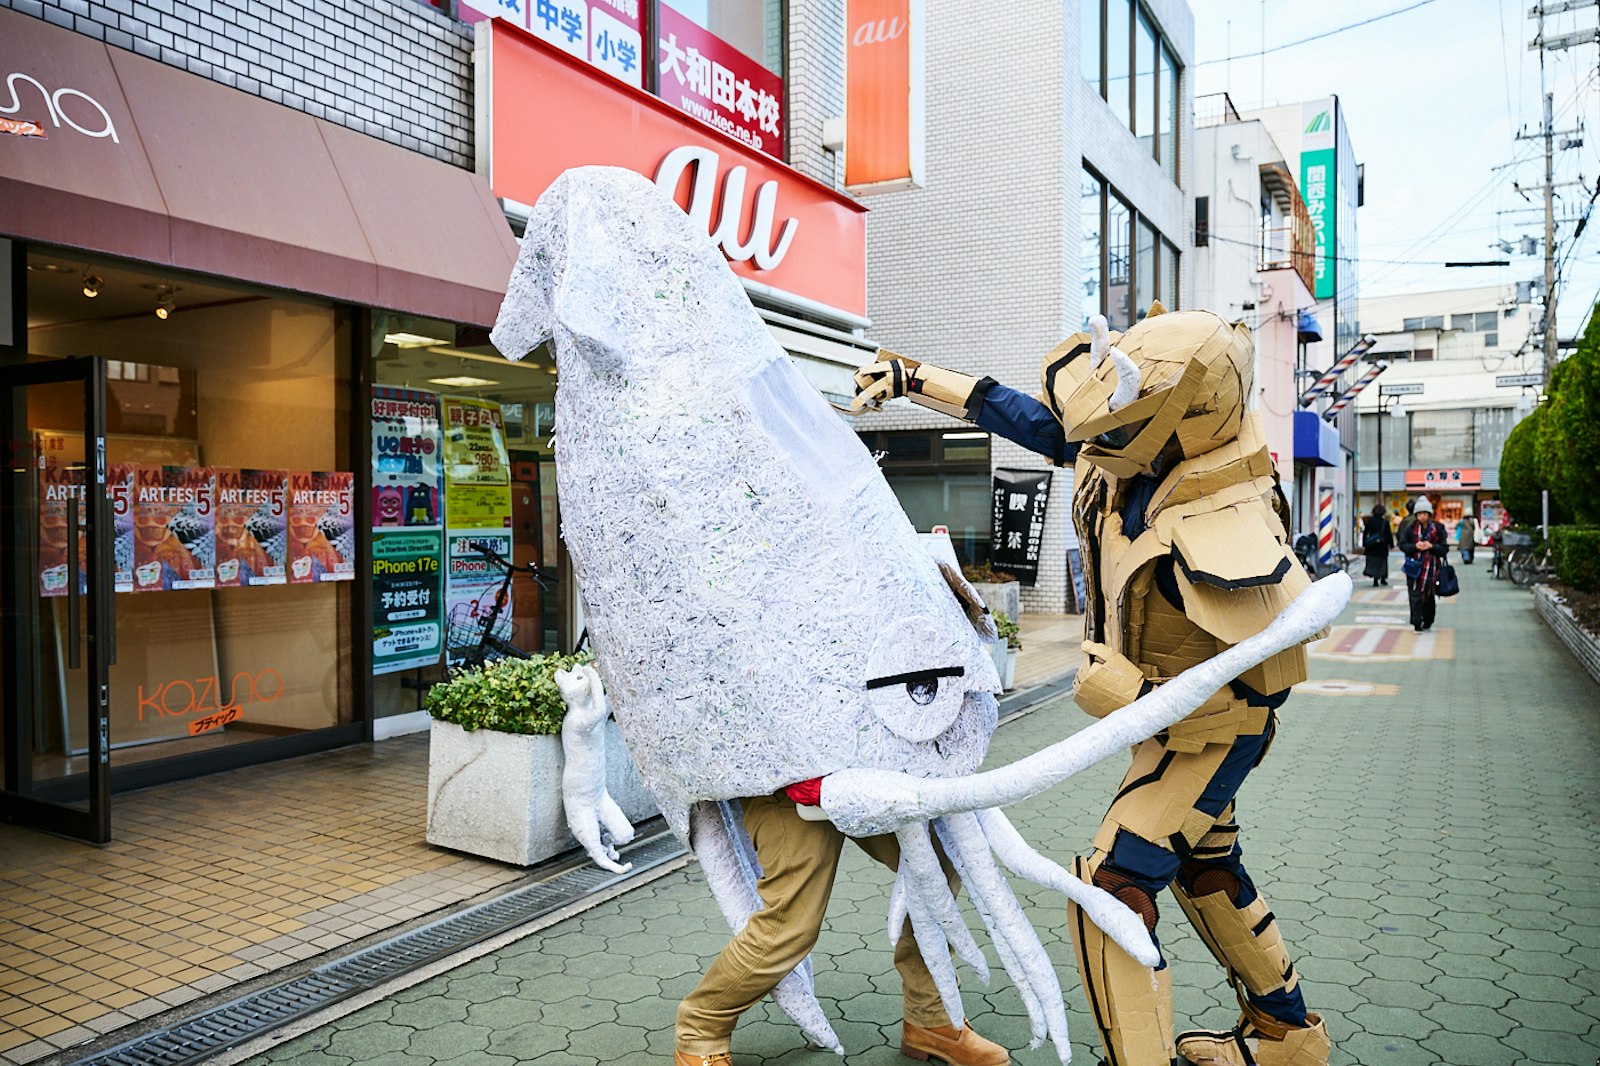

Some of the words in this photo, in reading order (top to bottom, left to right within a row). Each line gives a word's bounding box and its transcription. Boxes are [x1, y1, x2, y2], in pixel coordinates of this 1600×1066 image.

[537, 0, 582, 43] 中学
[853, 16, 907, 47] au
[596, 30, 636, 73] 小学
[659, 33, 780, 138] 大和田本校
[681, 95, 763, 150] www.kec.ne.jp
[655, 146, 799, 271] au
[112, 486, 129, 515] 5
[373, 559, 415, 574] iPhone
[417, 557, 438, 571] 17e
[452, 559, 486, 572] iPhone
[381, 589, 430, 609] 予約受付
